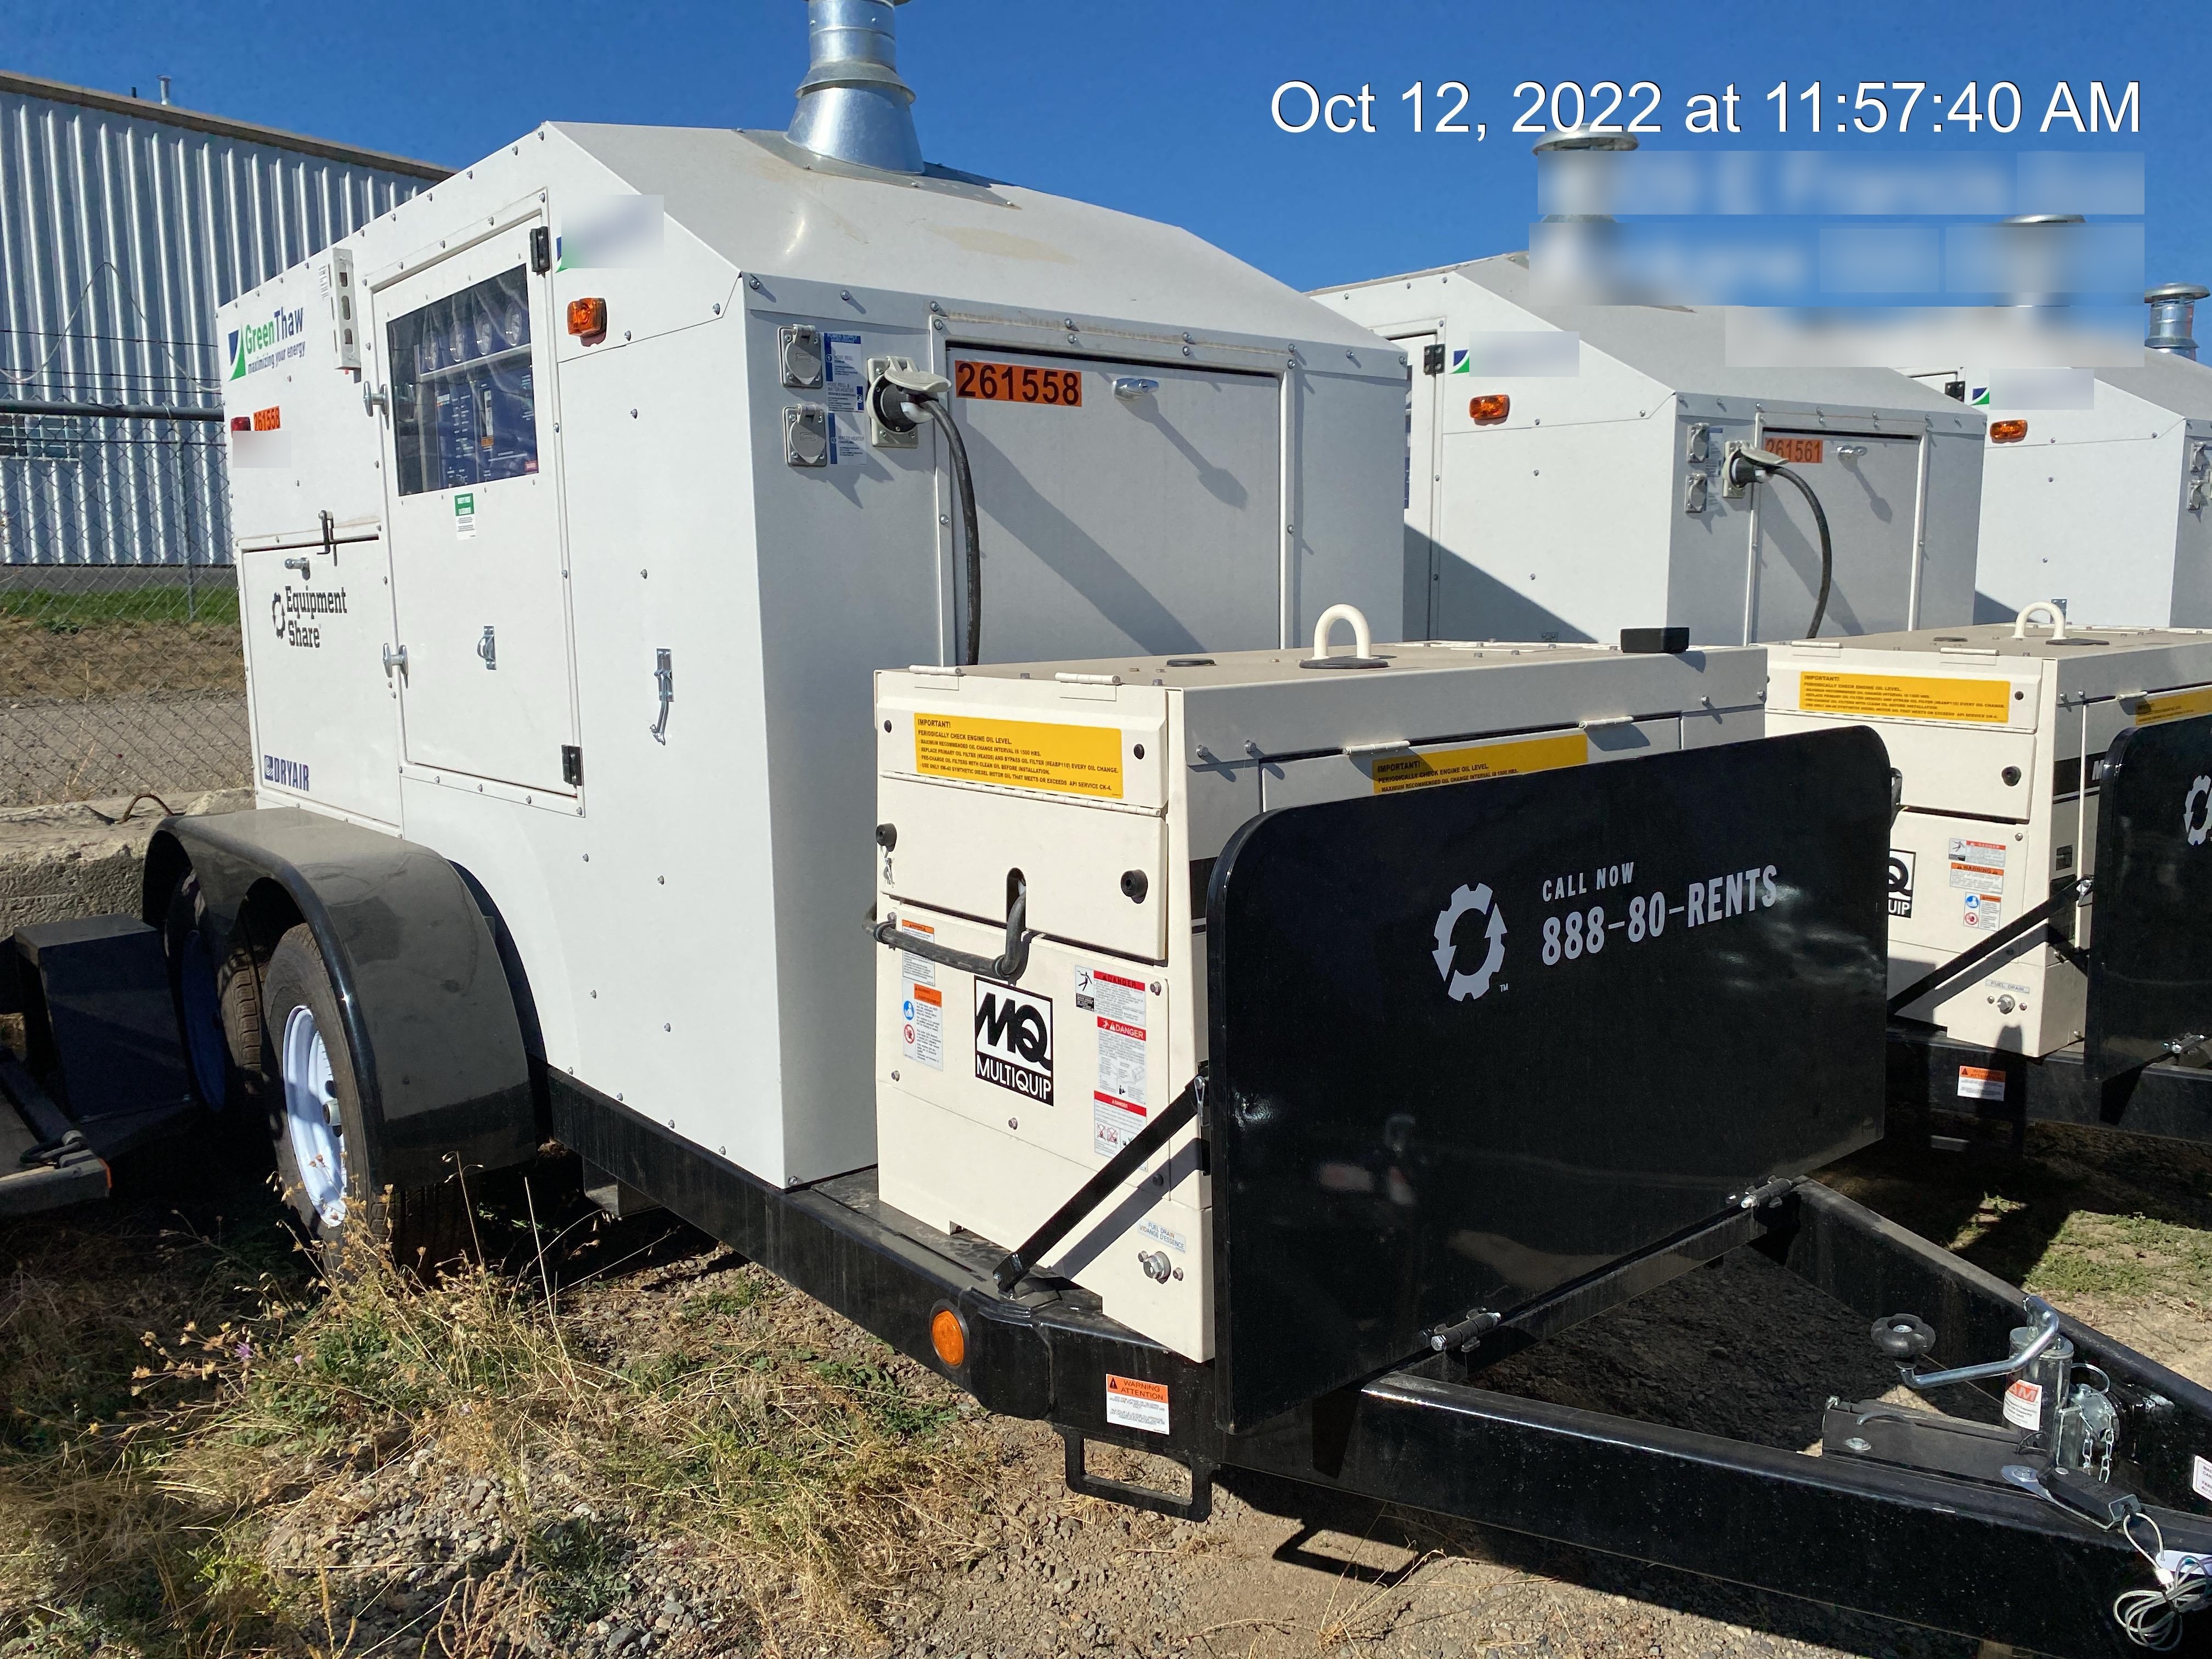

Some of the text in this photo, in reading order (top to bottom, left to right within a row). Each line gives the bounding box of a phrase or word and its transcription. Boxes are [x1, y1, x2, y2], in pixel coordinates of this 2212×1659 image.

[245, 307, 303, 354] GreenThaw
[248, 341, 306, 374] maximizing your energy
[957, 362, 1080, 405] 261558
[253, 407, 280, 431] 261558
[285, 585, 347, 619] Equipment
[288, 620, 320, 648] Share
[918, 719, 951, 728] IMPORTANT!
[918, 730, 949, 738] PERIODICALLY
[274, 757, 309, 792] DRYAIR
[1378, 760, 1421, 774] IMPORTANT!
[1378, 772, 1419, 783] PERIODICALLY
[1419, 770, 1438, 778] CHECK
[1440, 766, 1460, 776] ENGINE
[1542, 861, 1634, 902] CALL NOW
[1542, 864, 1778, 966] 888-80-RENTS
[1499, 983, 1509, 992] TM
[975, 991, 1051, 1071] MQ
[1115, 1024, 1144, 1039] DANGER
[977, 1054, 1052, 1100] MULTIQUIP
[1139, 1224, 1159, 1238] VIDANGE
[1148, 1222, 1175, 1239] FUEL DRAIN
[1120, 1387, 1164, 1401] ATTENTION
[1124, 1380, 1160, 1392] WARNING
